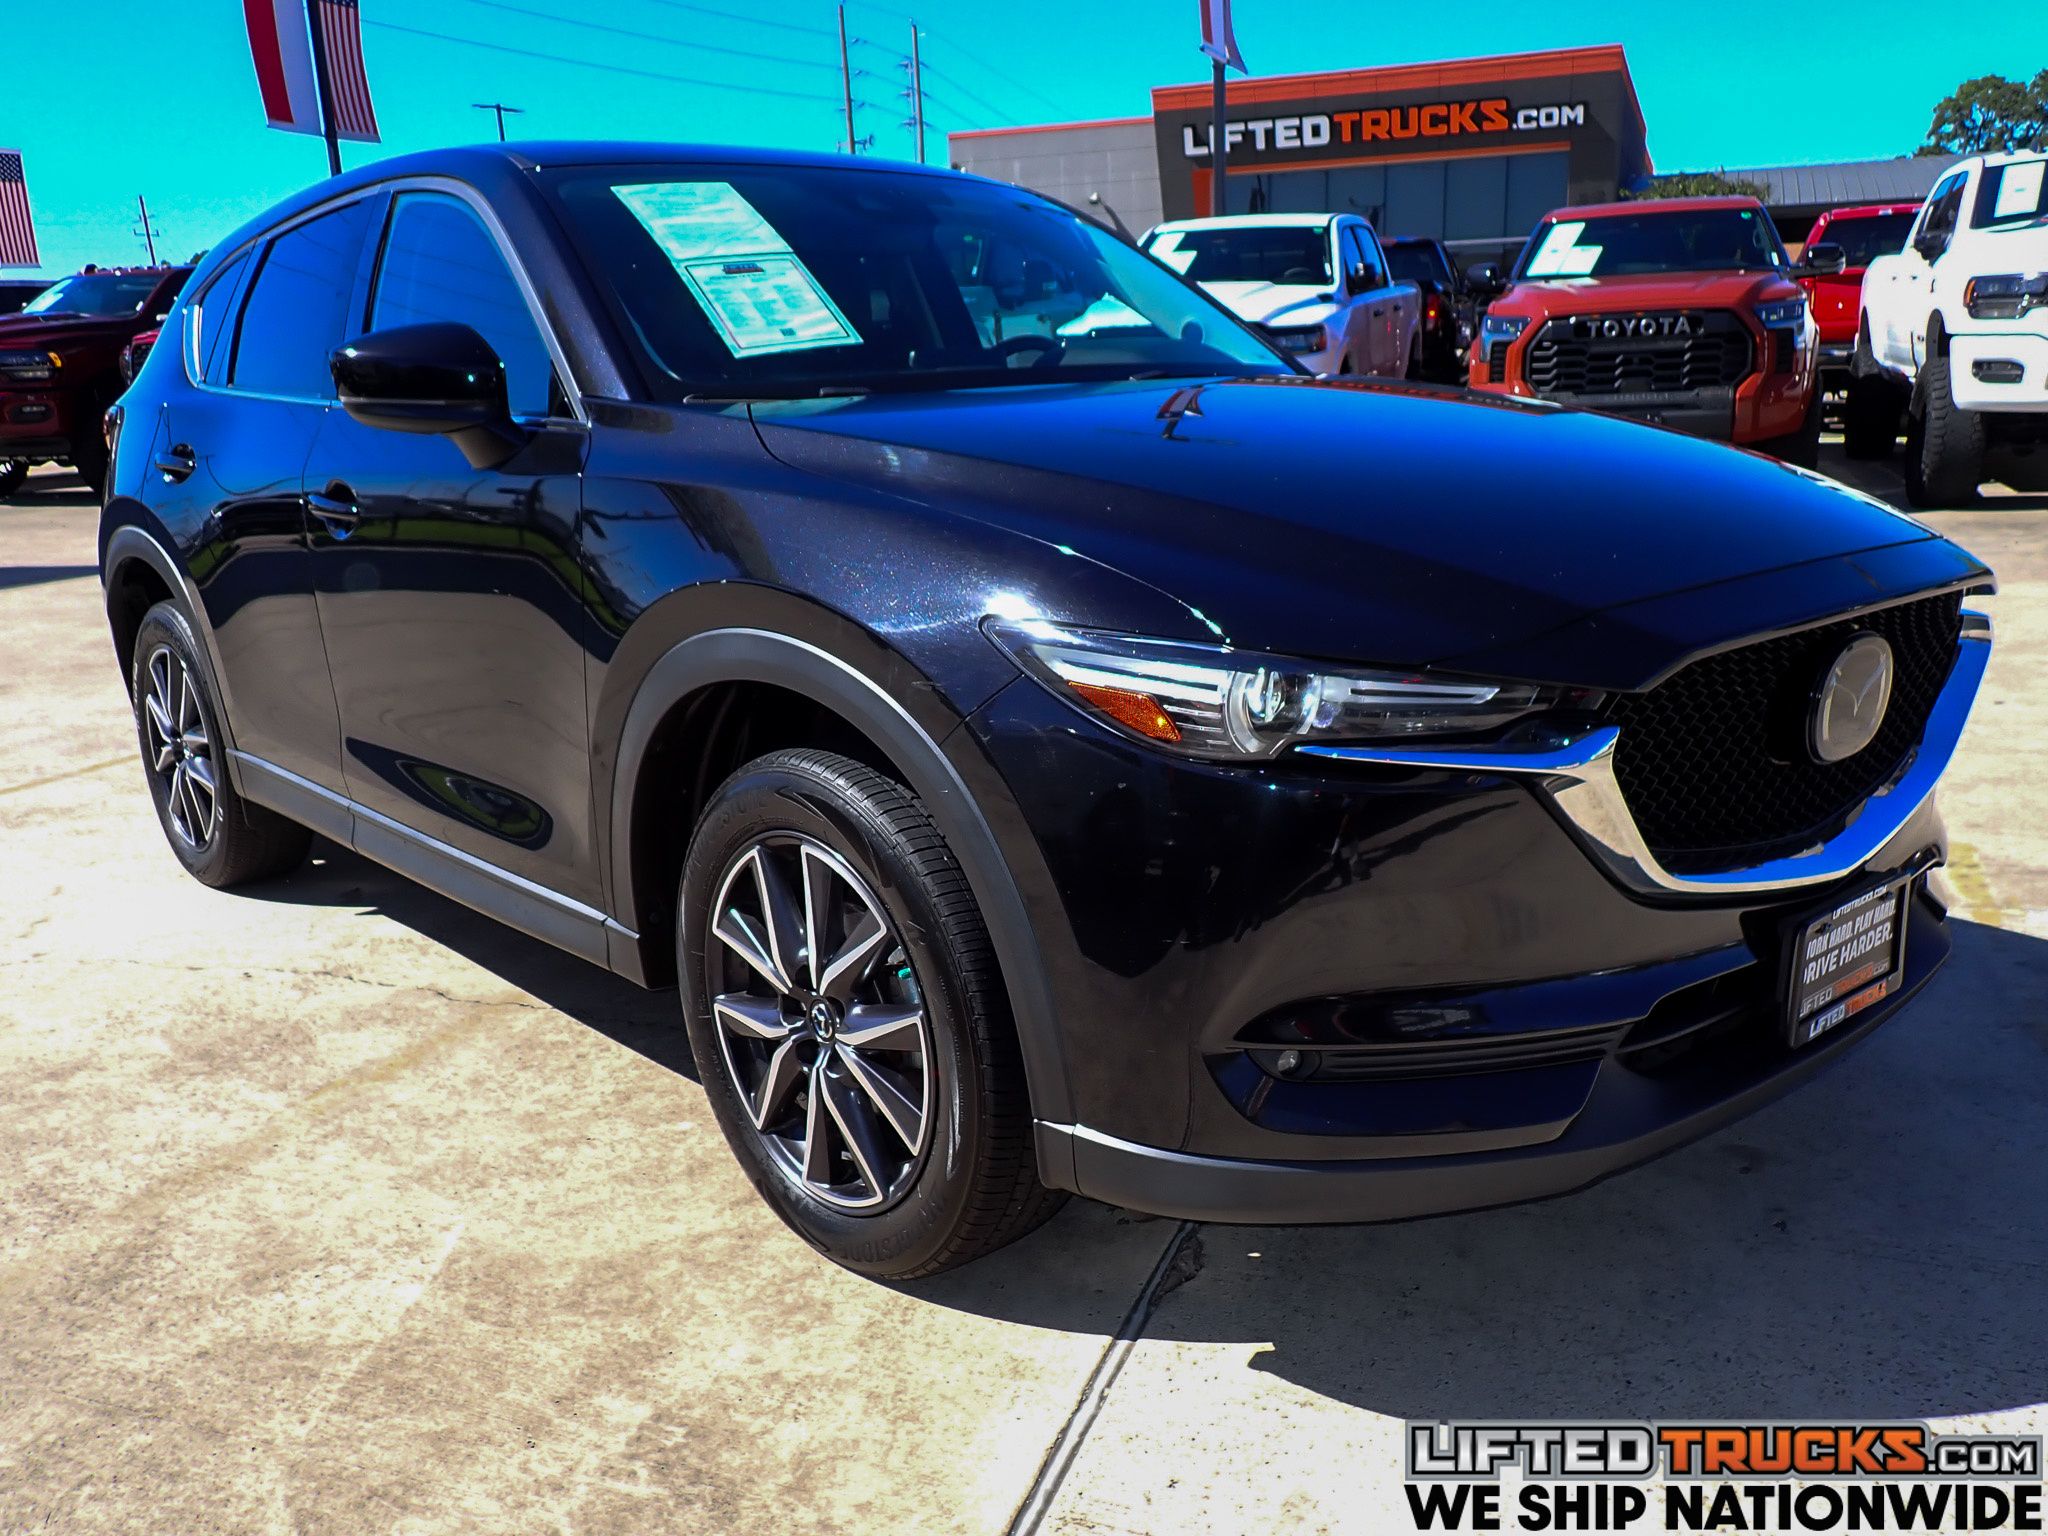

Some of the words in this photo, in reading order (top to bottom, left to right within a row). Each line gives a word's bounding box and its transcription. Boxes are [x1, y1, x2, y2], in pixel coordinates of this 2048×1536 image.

[1587, 315, 1691, 339] TOYOTA
[1854, 909, 1874, 935] PLAY
[1839, 921, 1893, 967] HARDER.
